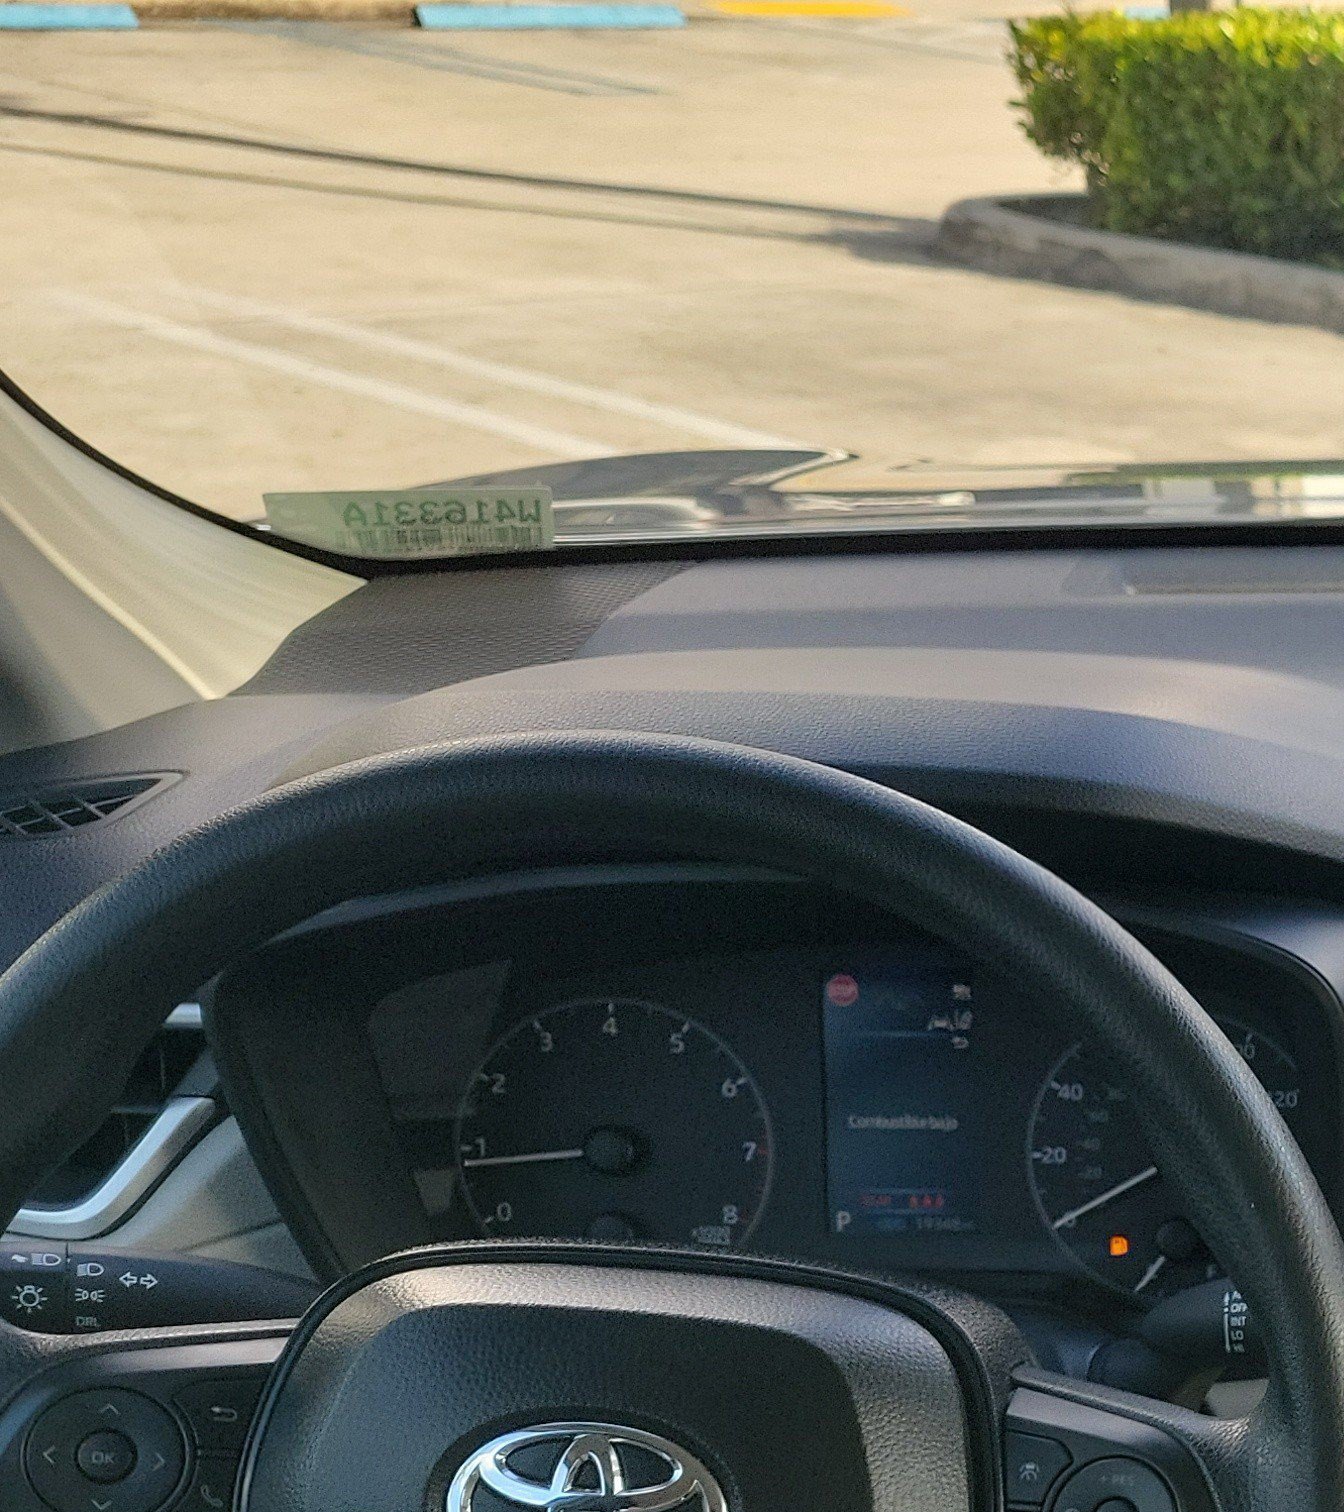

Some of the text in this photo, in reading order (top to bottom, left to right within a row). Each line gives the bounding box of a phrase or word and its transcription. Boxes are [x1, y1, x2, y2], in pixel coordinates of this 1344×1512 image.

[670, 1033, 684, 1053] 5
[491, 1074, 506, 1094] 2
[721, 1078, 737, 1098] 6
[1057, 1083, 1084, 1101] 40
[743, 1142, 756, 1162] 7
[1041, 1147, 1067, 1165] 20
[92, 1451, 115, 1465] OK
